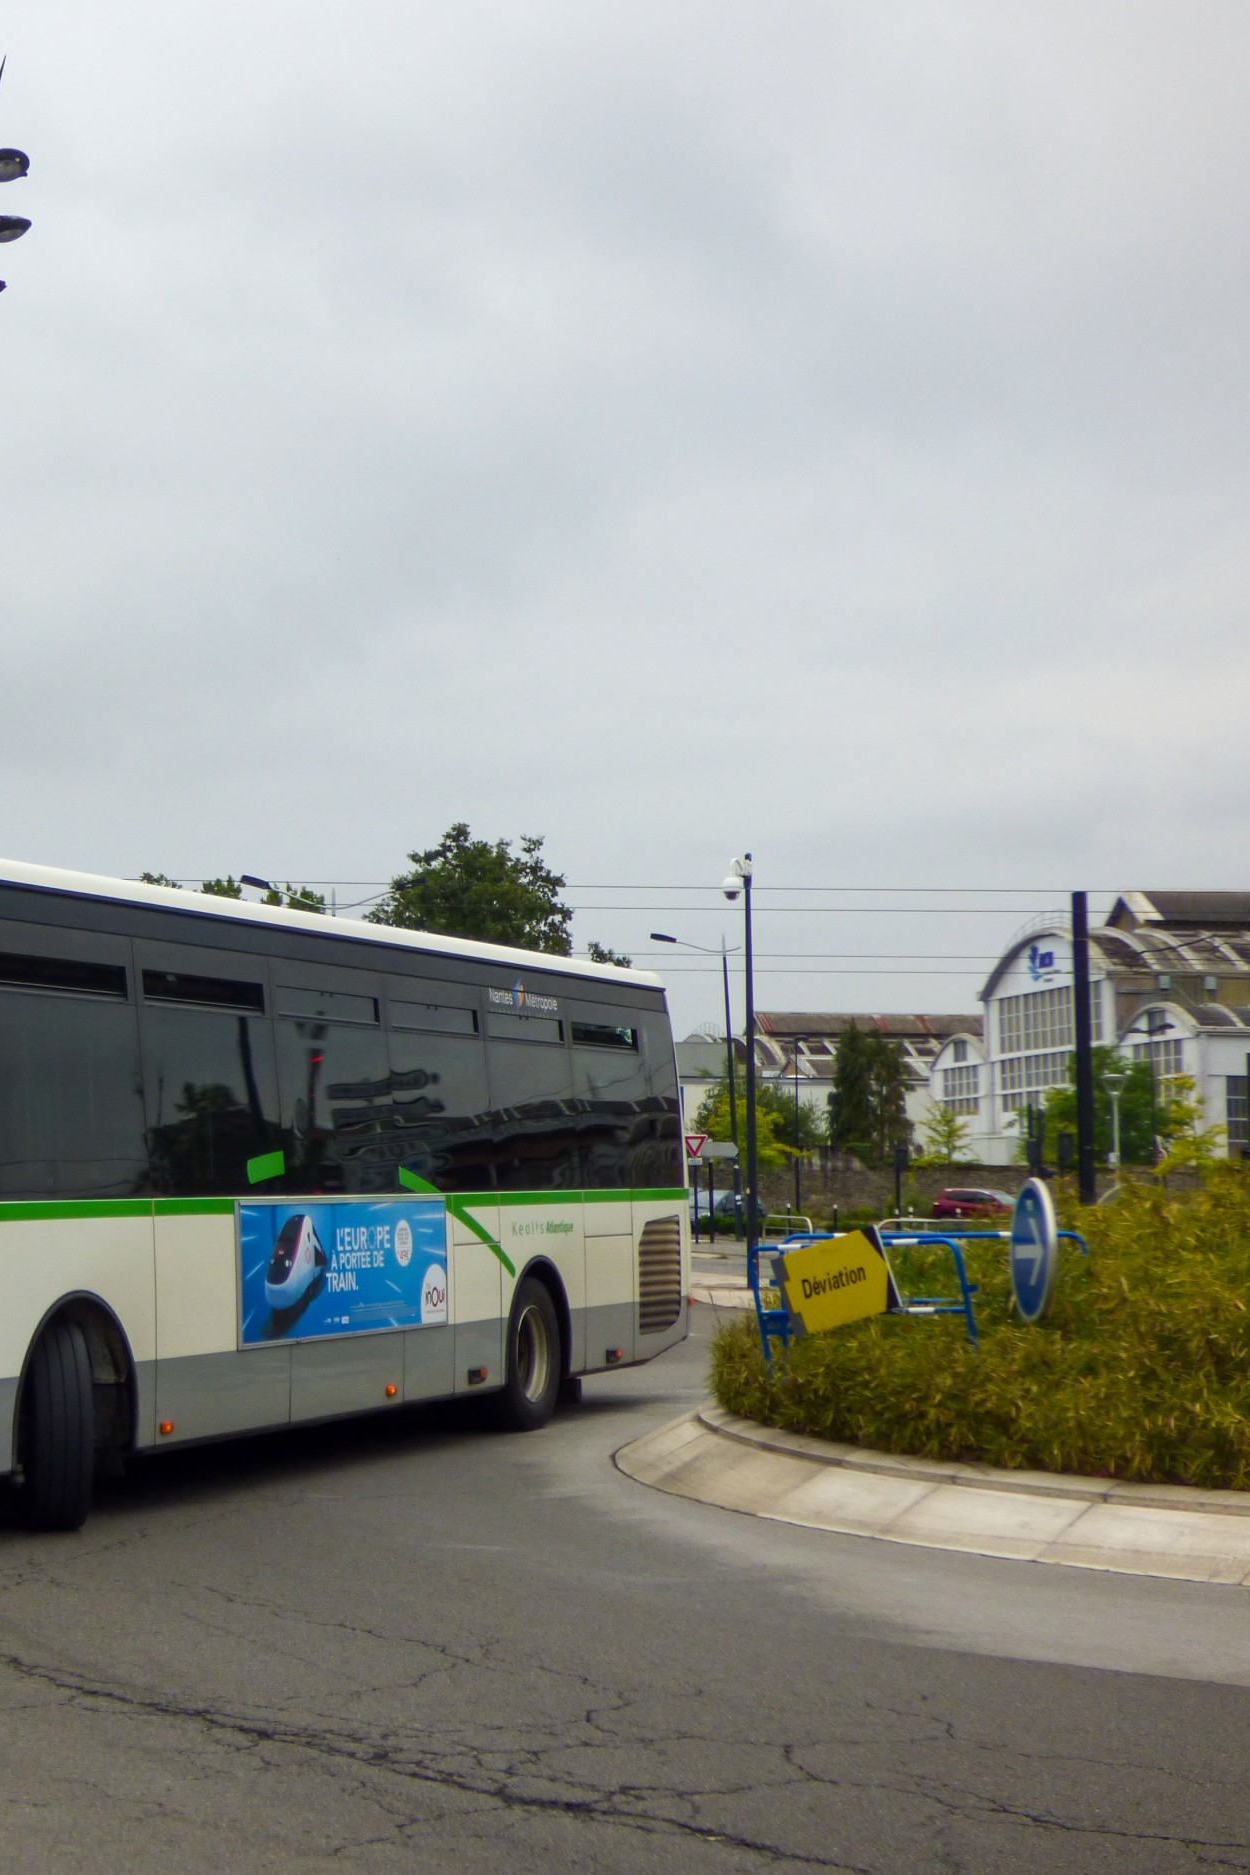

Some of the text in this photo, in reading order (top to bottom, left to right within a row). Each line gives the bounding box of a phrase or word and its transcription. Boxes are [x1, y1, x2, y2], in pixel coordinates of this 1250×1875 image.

[489, 987, 558, 1012] Nantes Métropole
[336, 1225, 391, 1251] L'EUROPE
[511, 1219, 574, 1236] Keolis Atlantique
[331, 1249, 385, 1271] À PORTÉE DE
[326, 1271, 359, 1293] TRAIN.
[801, 1265, 866, 1299] Déviation
